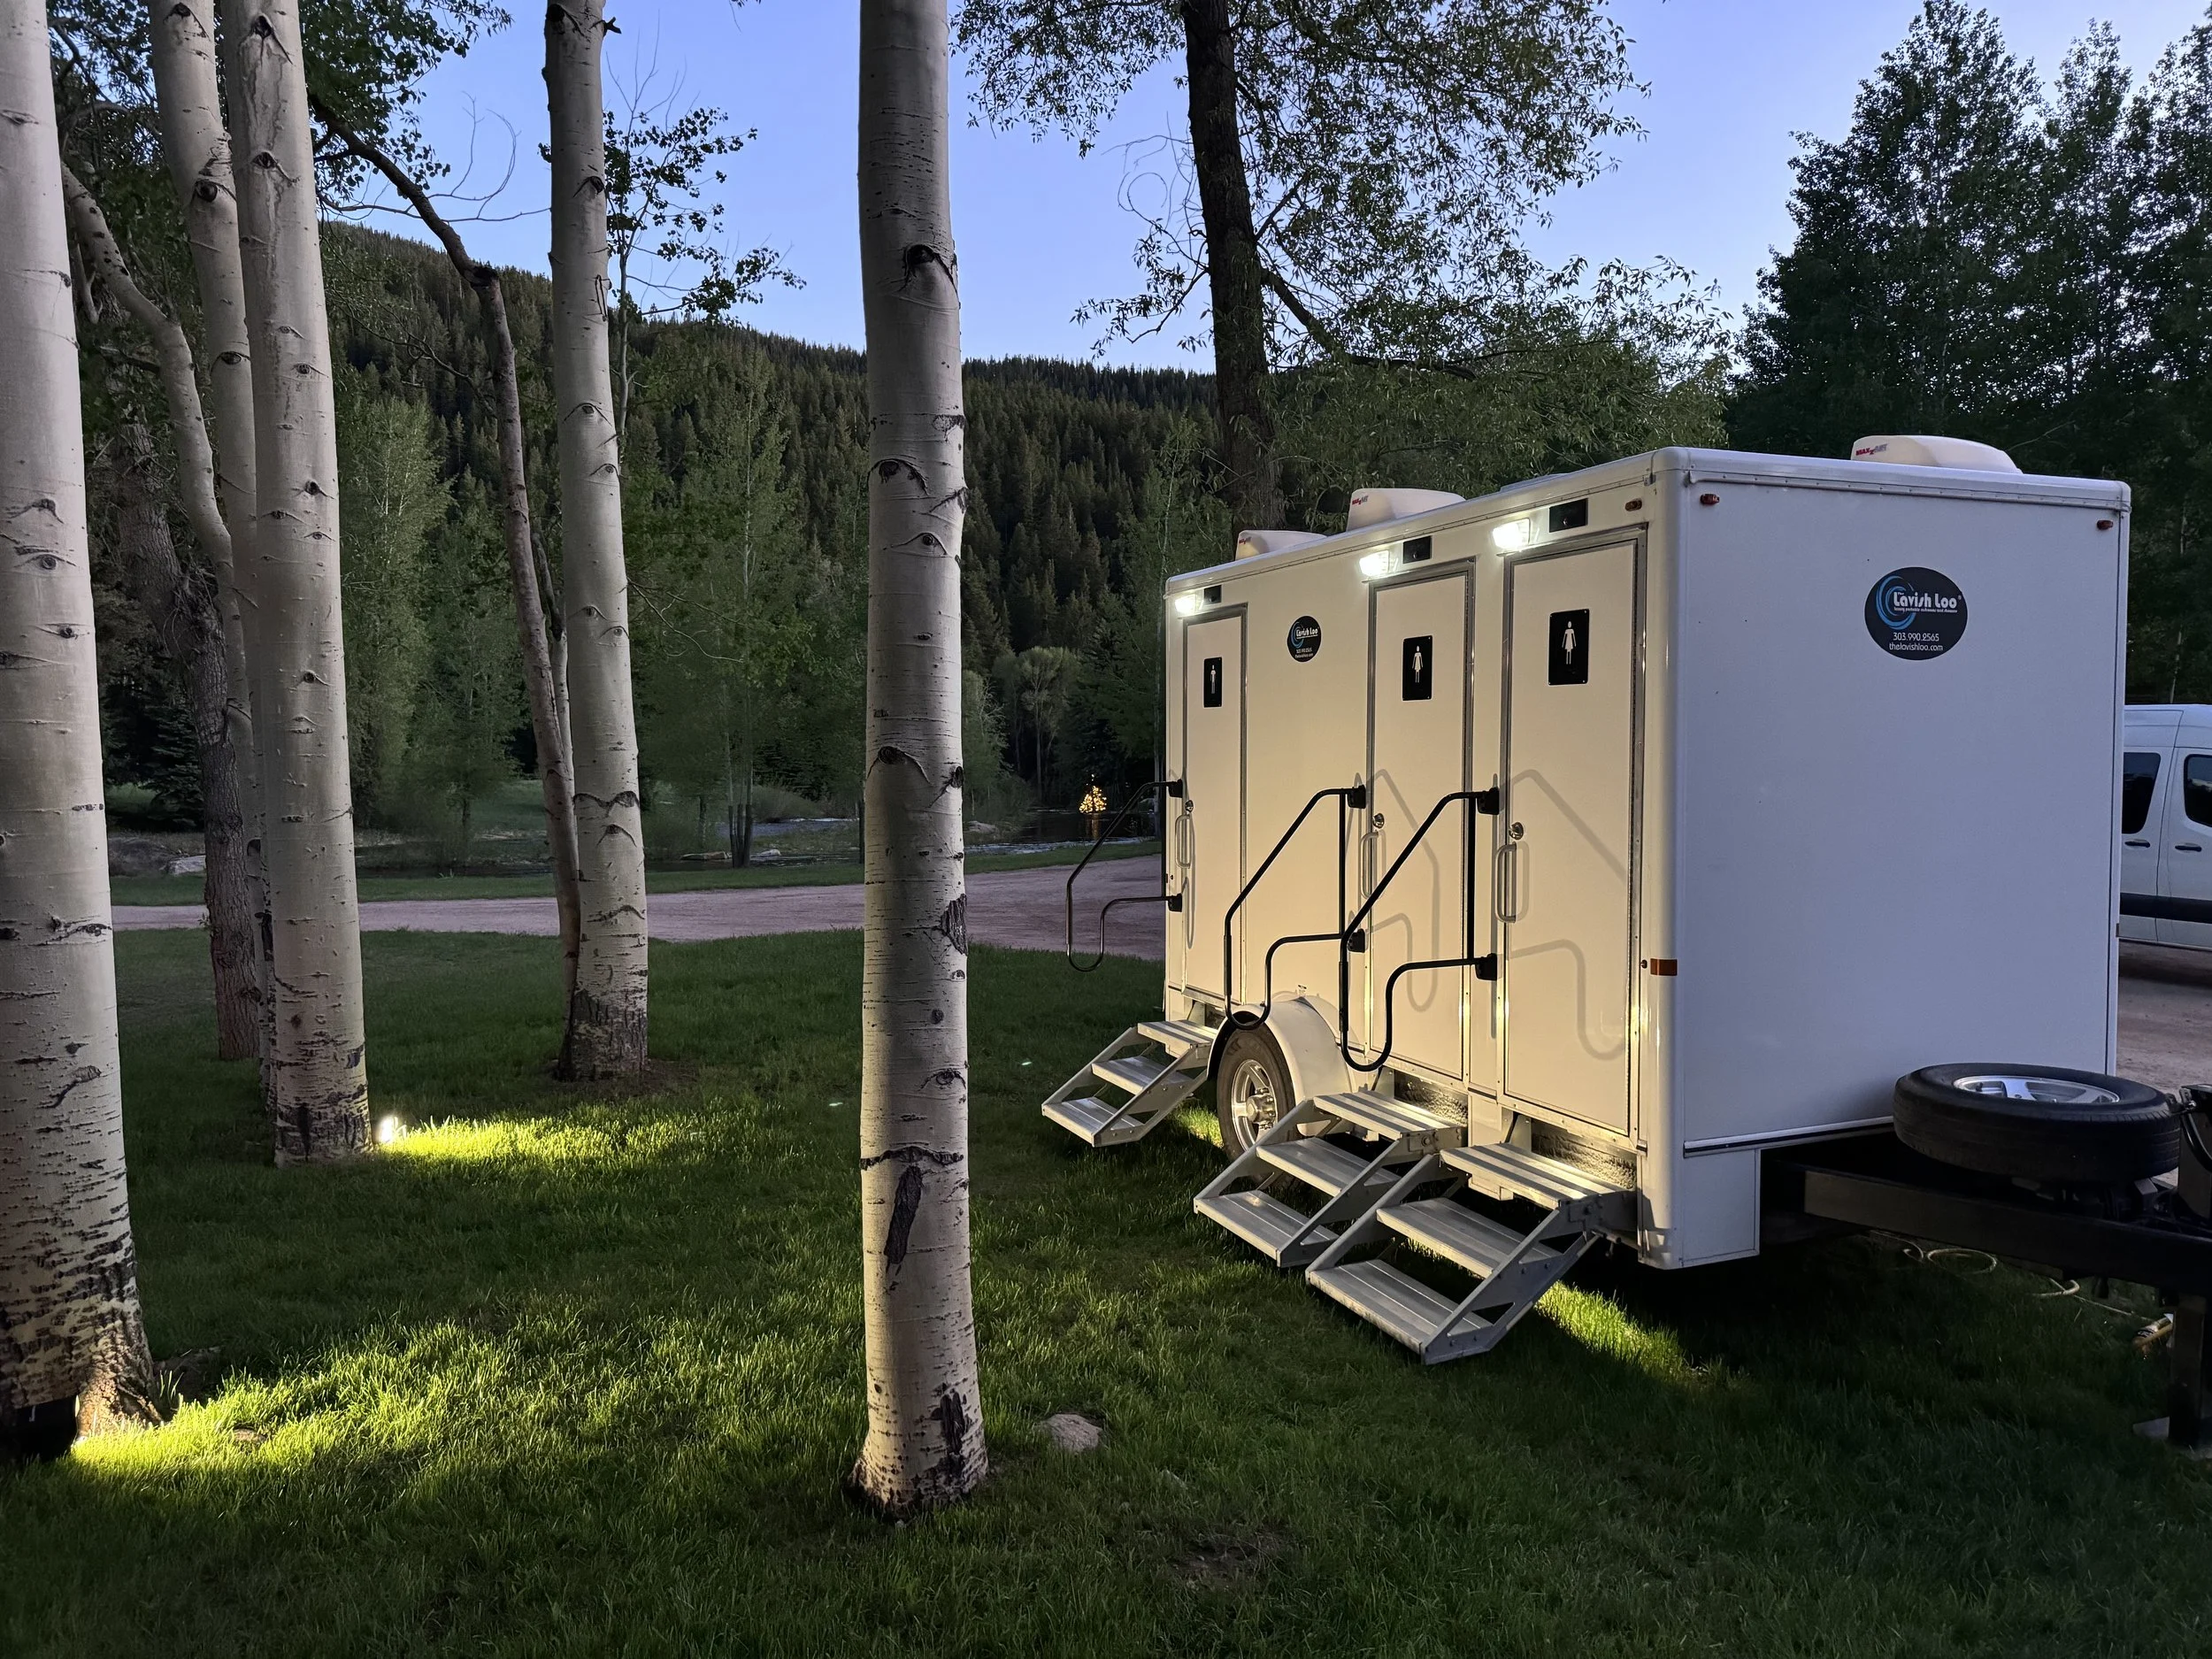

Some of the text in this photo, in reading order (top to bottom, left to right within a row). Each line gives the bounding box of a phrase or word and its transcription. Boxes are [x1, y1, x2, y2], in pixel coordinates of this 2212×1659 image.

[1893, 591, 1957, 609] Lavish Loo
[1893, 632, 1939, 641] 303.990.2565
[1889, 642, 1943, 651] thelavishloo.com
